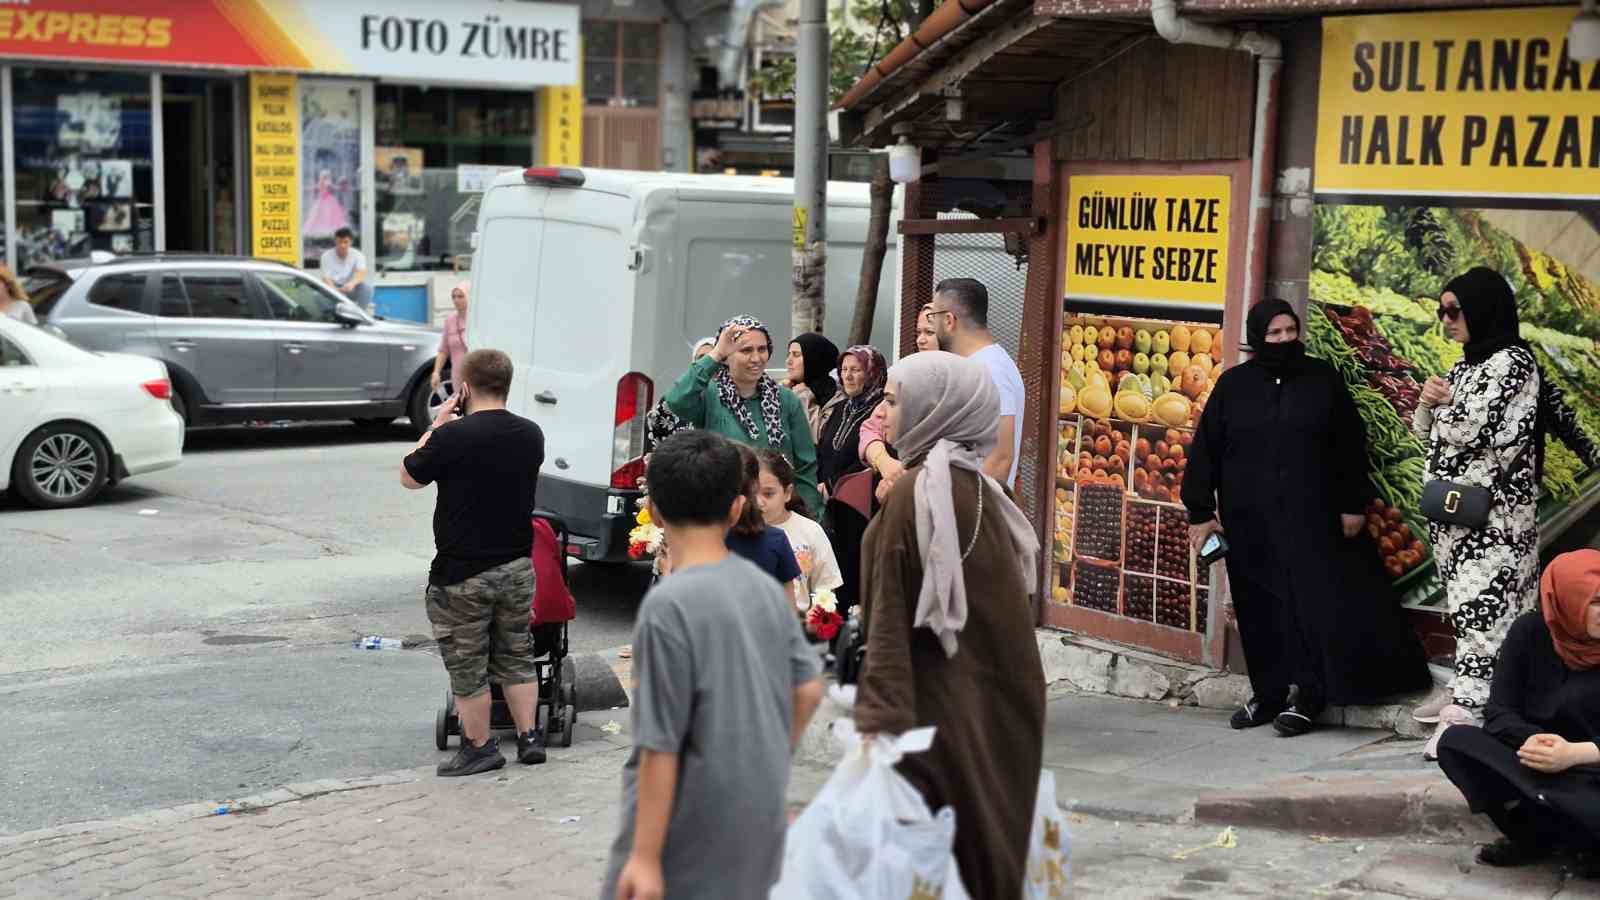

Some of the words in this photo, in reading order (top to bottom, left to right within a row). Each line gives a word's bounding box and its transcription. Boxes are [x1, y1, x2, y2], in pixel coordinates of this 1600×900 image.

[0, 8, 172, 47] EXPRESS
[361, 15, 448, 55] FOTO
[460, 15, 570, 62] ZÜMRE
[1339, 115, 1446, 166] HALK
[1078, 191, 1157, 231] GÜNLÜK
[1165, 198, 1220, 233] TAZE
[1075, 243, 1146, 279] MEYVE
[1152, 246, 1218, 283] SEBZE
